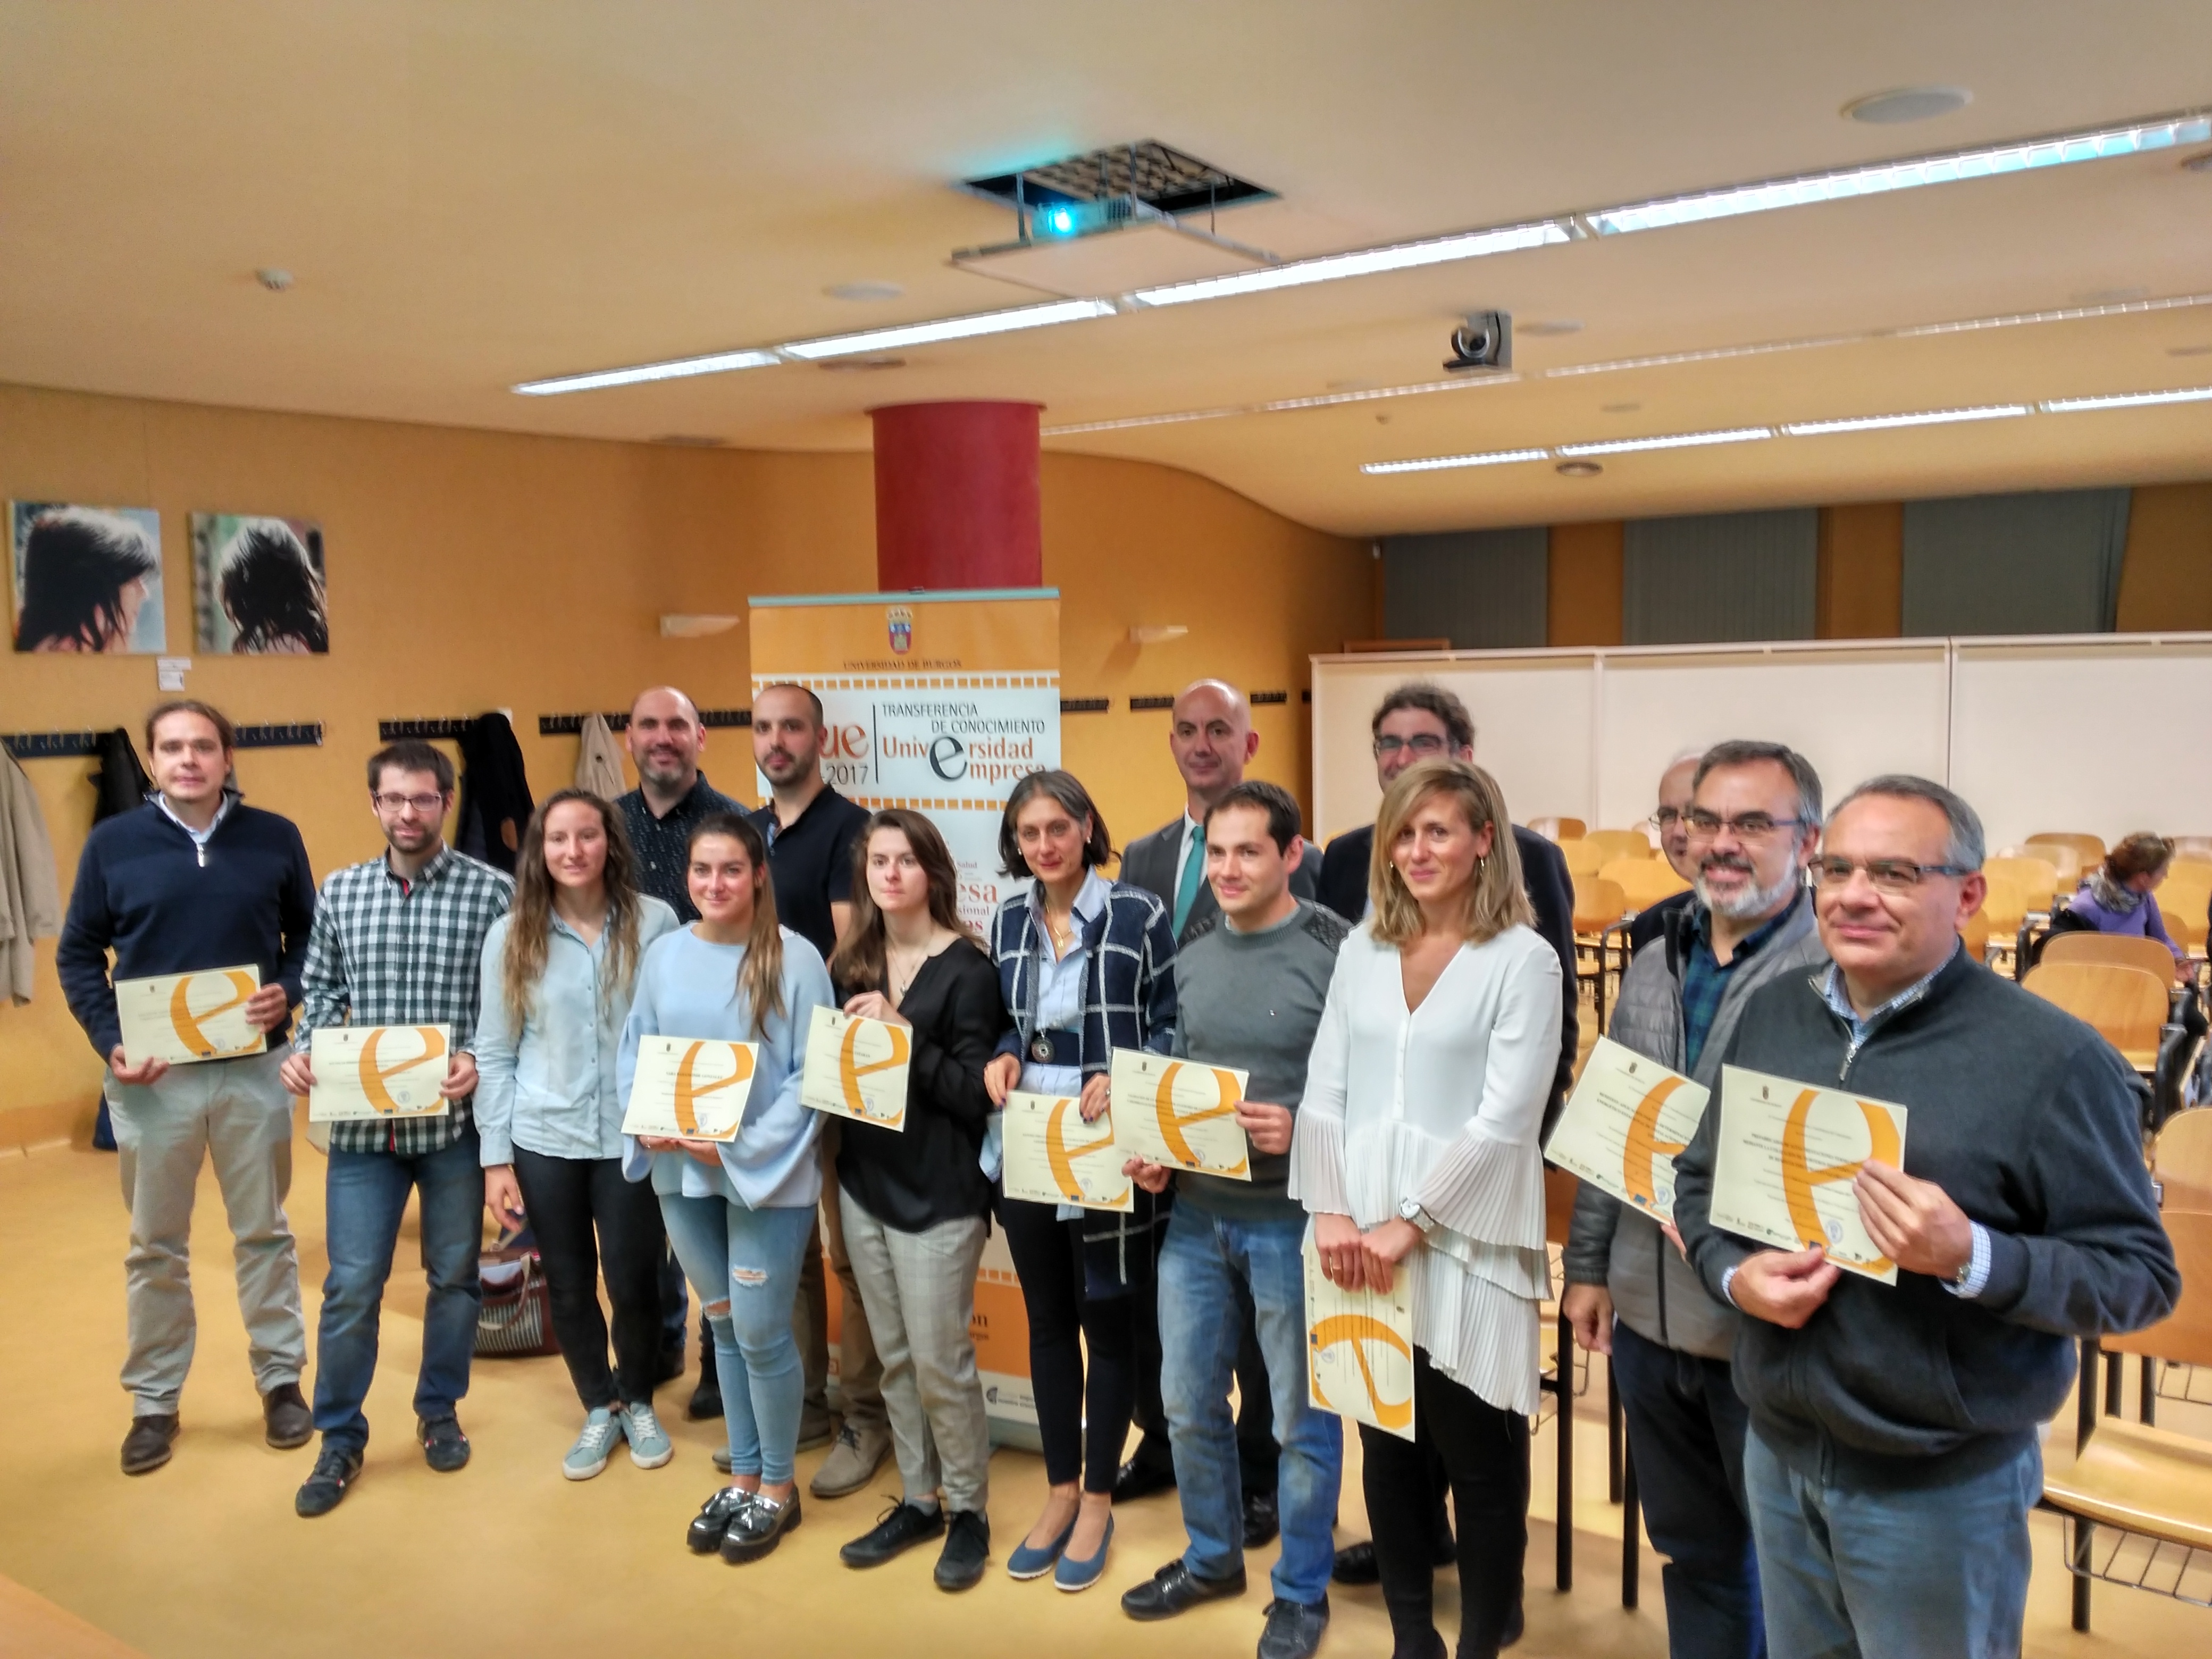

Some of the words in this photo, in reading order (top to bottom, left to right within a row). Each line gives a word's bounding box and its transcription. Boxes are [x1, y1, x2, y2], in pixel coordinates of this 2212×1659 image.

[843, 659, 904, 670] UNIVERSIDAD
[908, 659, 919, 670] DE
[882, 701, 978, 718] TRANSFERENCIA
[932, 719, 947, 734] DE
[951, 718, 1045, 734] CONOCIMIENTO
[819, 725, 869, 759] ue
[957, 883, 998, 903] esa
[957, 904, 990, 916] sional
